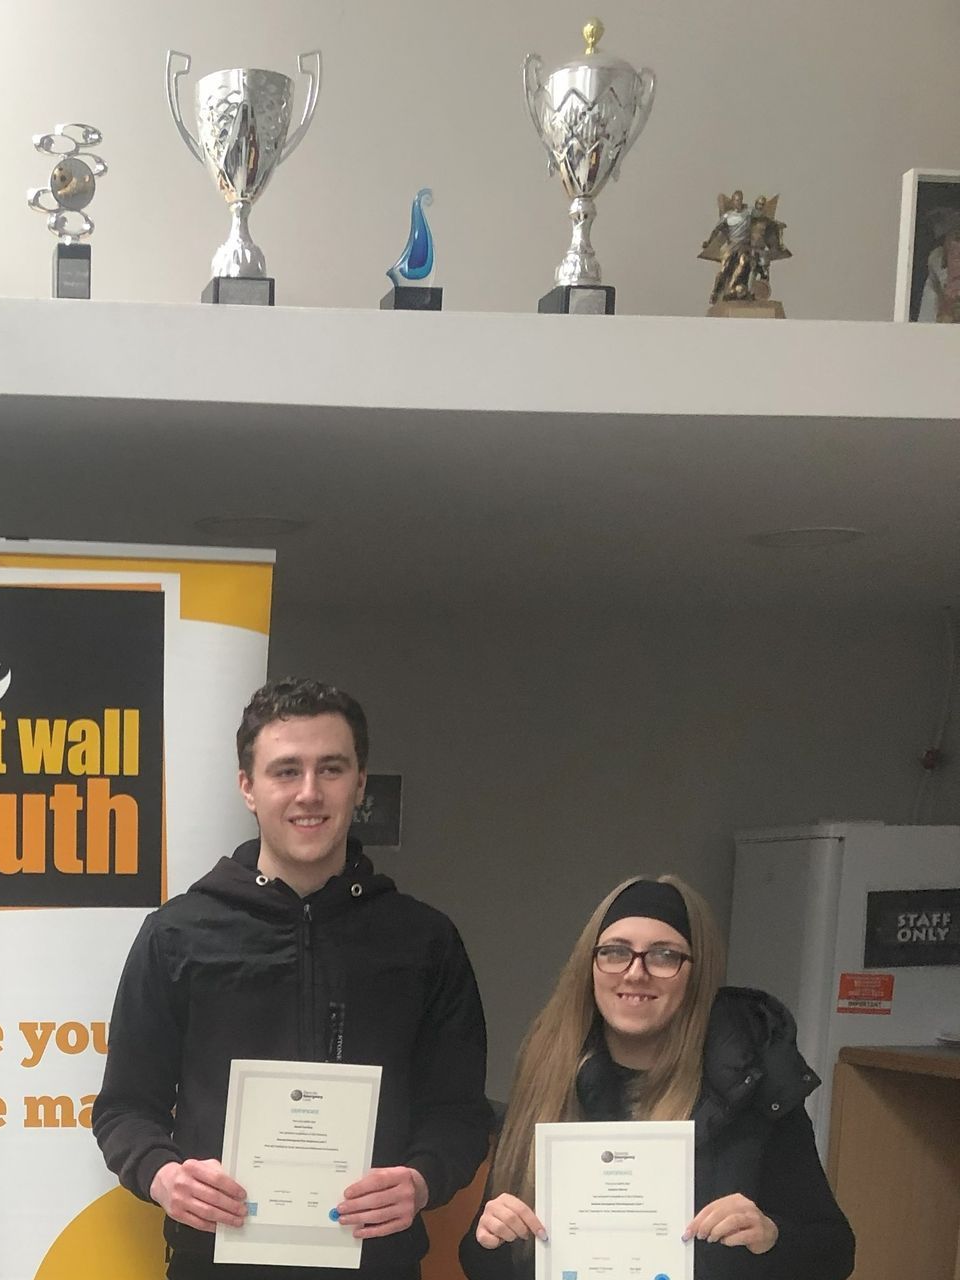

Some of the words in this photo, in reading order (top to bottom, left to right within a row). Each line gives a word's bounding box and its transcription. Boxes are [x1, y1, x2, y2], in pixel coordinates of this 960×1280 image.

[17, 709, 140, 776] wall
[897, 912, 951, 927] STAFF
[897, 927, 949, 942] ONLY
